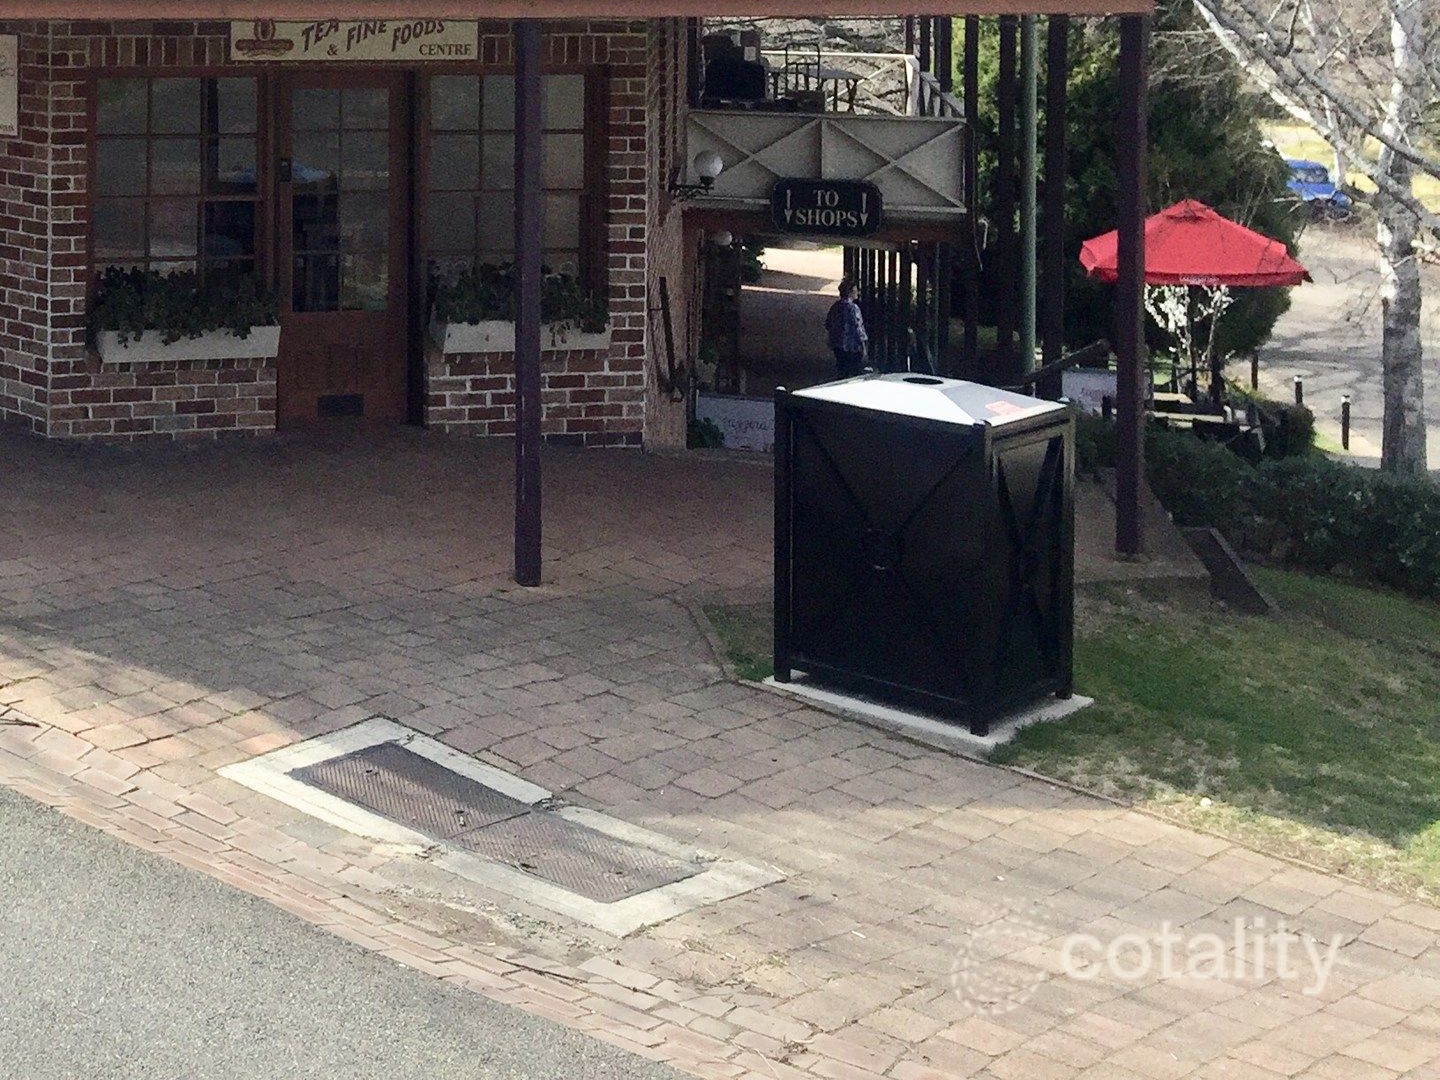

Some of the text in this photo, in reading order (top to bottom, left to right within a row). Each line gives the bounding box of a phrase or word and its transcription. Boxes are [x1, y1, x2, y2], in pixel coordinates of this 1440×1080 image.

[301, 19, 339, 52] TEA
[327, 43, 338, 56] &
[346, 19, 387, 52] FINE
[391, 20, 445, 52] FOODS
[813, 190, 839, 206] TO
[795, 209, 858, 228] SHOPS
